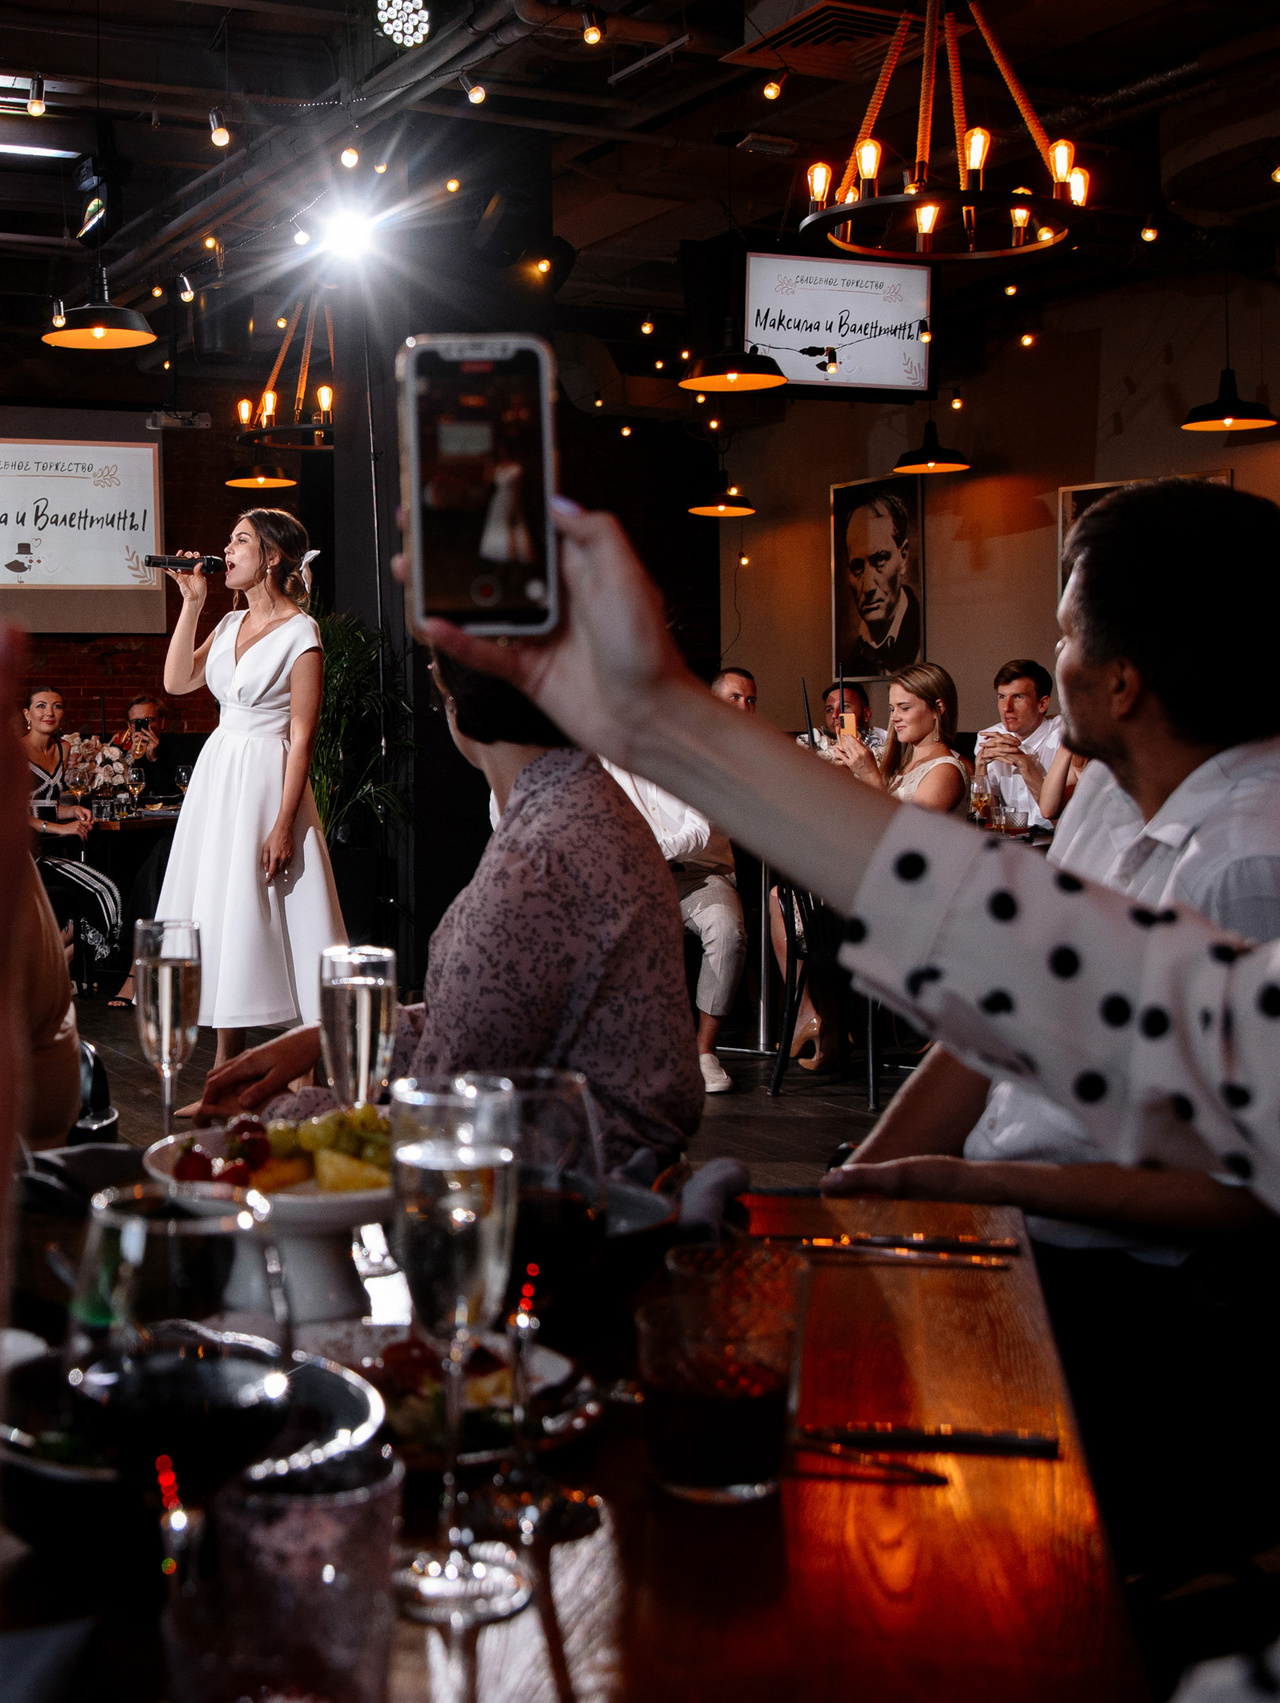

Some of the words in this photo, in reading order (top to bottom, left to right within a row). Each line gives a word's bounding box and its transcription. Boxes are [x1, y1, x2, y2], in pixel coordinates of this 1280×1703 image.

[841, 278, 884, 290] ТОРЖЕСТВО
[755, 308, 821, 333] Максима
[825, 320, 833, 332] и
[838, 309, 921, 341] Валентины
[34, 461, 94, 473] ТОРЖЕСТВО
[15, 511, 27, 527] и
[33, 497, 148, 532] Валентины
